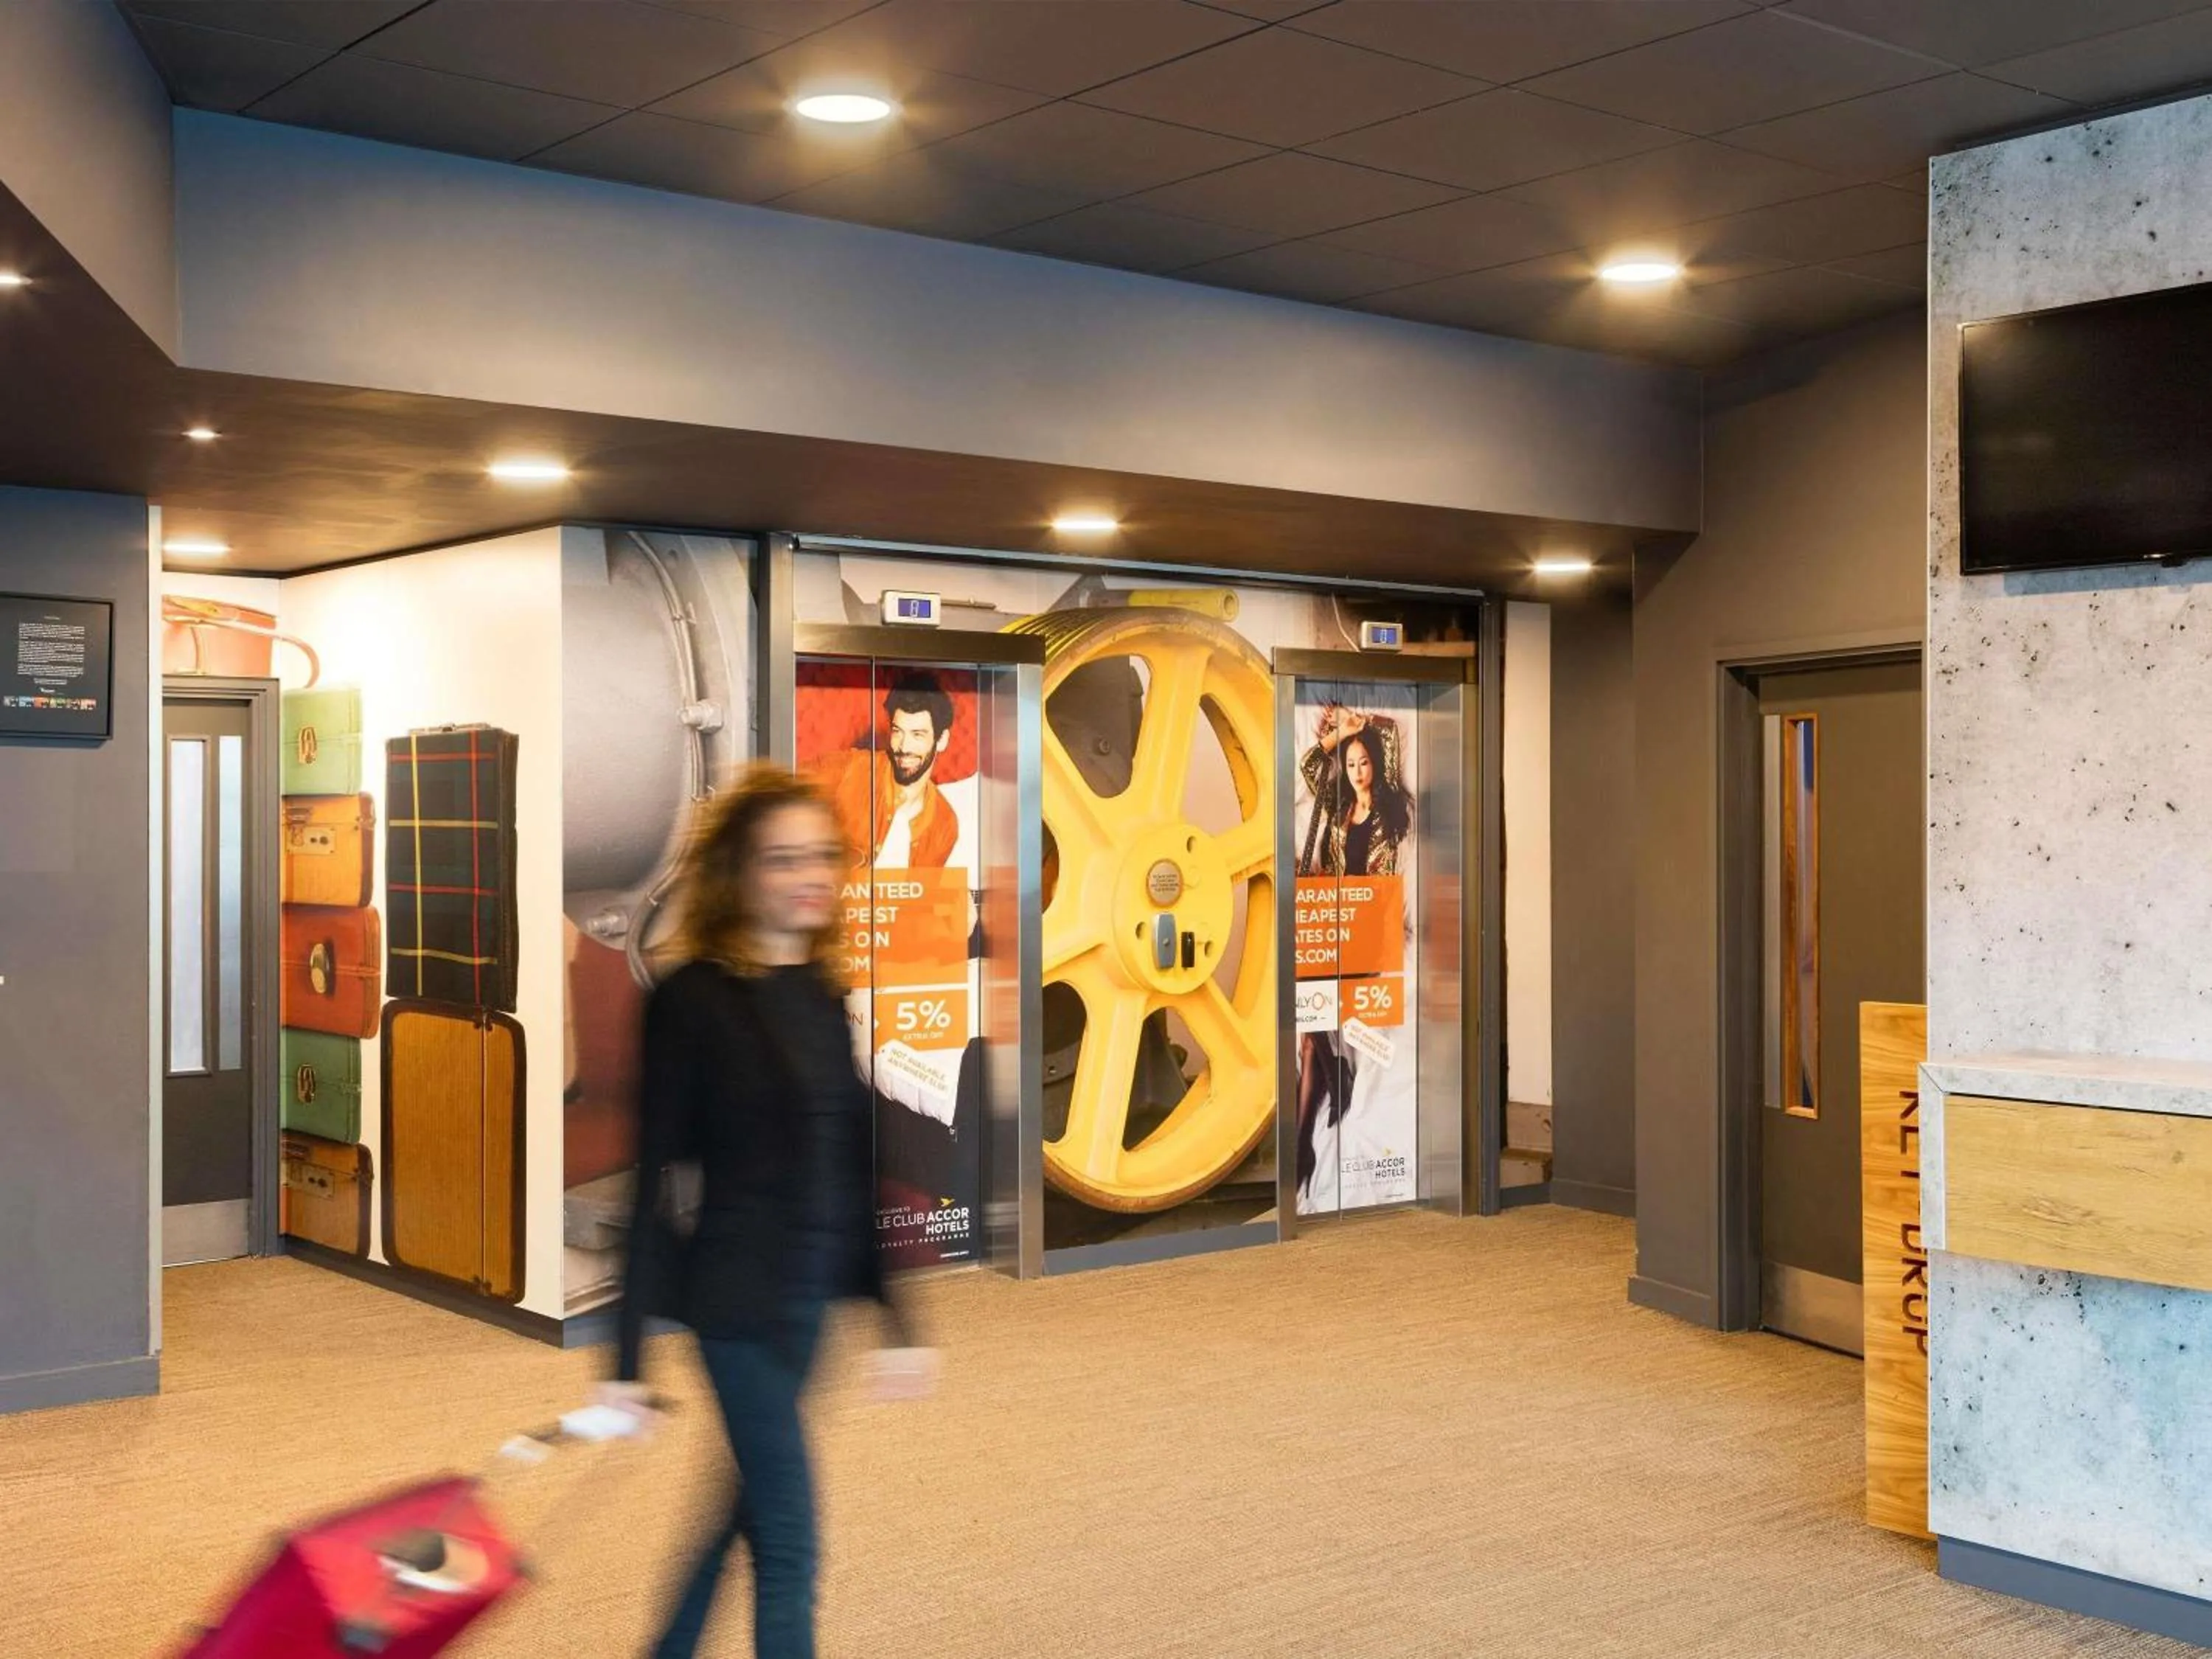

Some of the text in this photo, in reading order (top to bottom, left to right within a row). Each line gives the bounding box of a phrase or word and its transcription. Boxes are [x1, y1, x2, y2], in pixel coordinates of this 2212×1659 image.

[832, 882, 923, 899] ANTEED
[840, 906, 899, 924] PEST
[855, 931, 890, 947] ON
[1326, 928, 1350, 943] ON
[1354, 985, 1392, 1010] 5%
[896, 999, 951, 1031] 5%
[1375, 1157, 1405, 1169] ACCOR
[1375, 1167, 1405, 1179] HOTELS
[893, 1213, 925, 1228] CLUB
[926, 1207, 970, 1223] ACCOR
[925, 1220, 970, 1235] HOTELS
